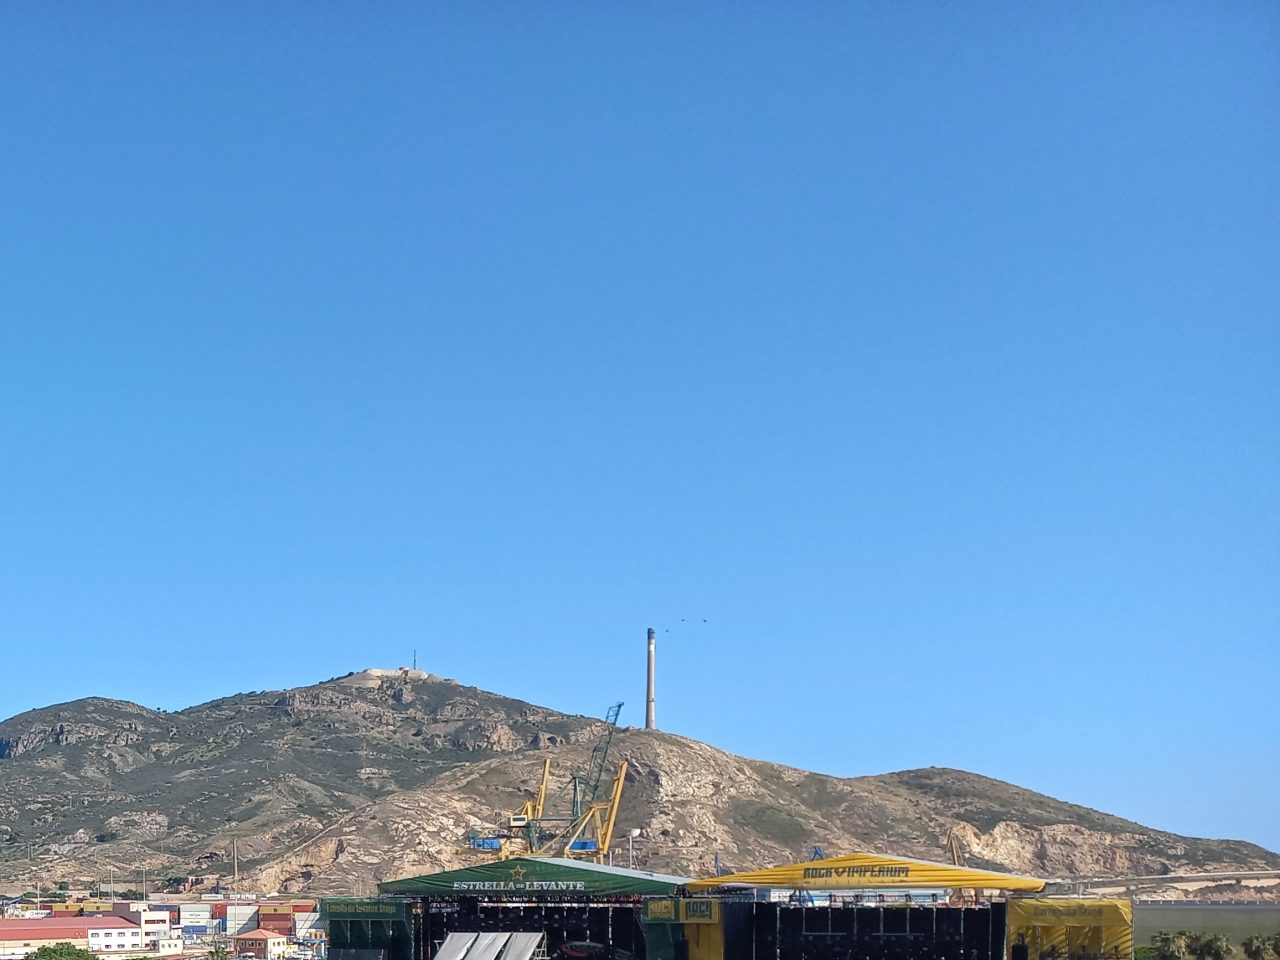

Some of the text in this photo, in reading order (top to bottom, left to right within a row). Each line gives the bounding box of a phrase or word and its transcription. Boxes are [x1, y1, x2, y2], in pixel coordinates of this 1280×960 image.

[803, 867, 909, 878] ROCK IMPERIUM
[452, 881, 516, 891] ESTRELLA
[525, 881, 585, 891] LEVANTE
